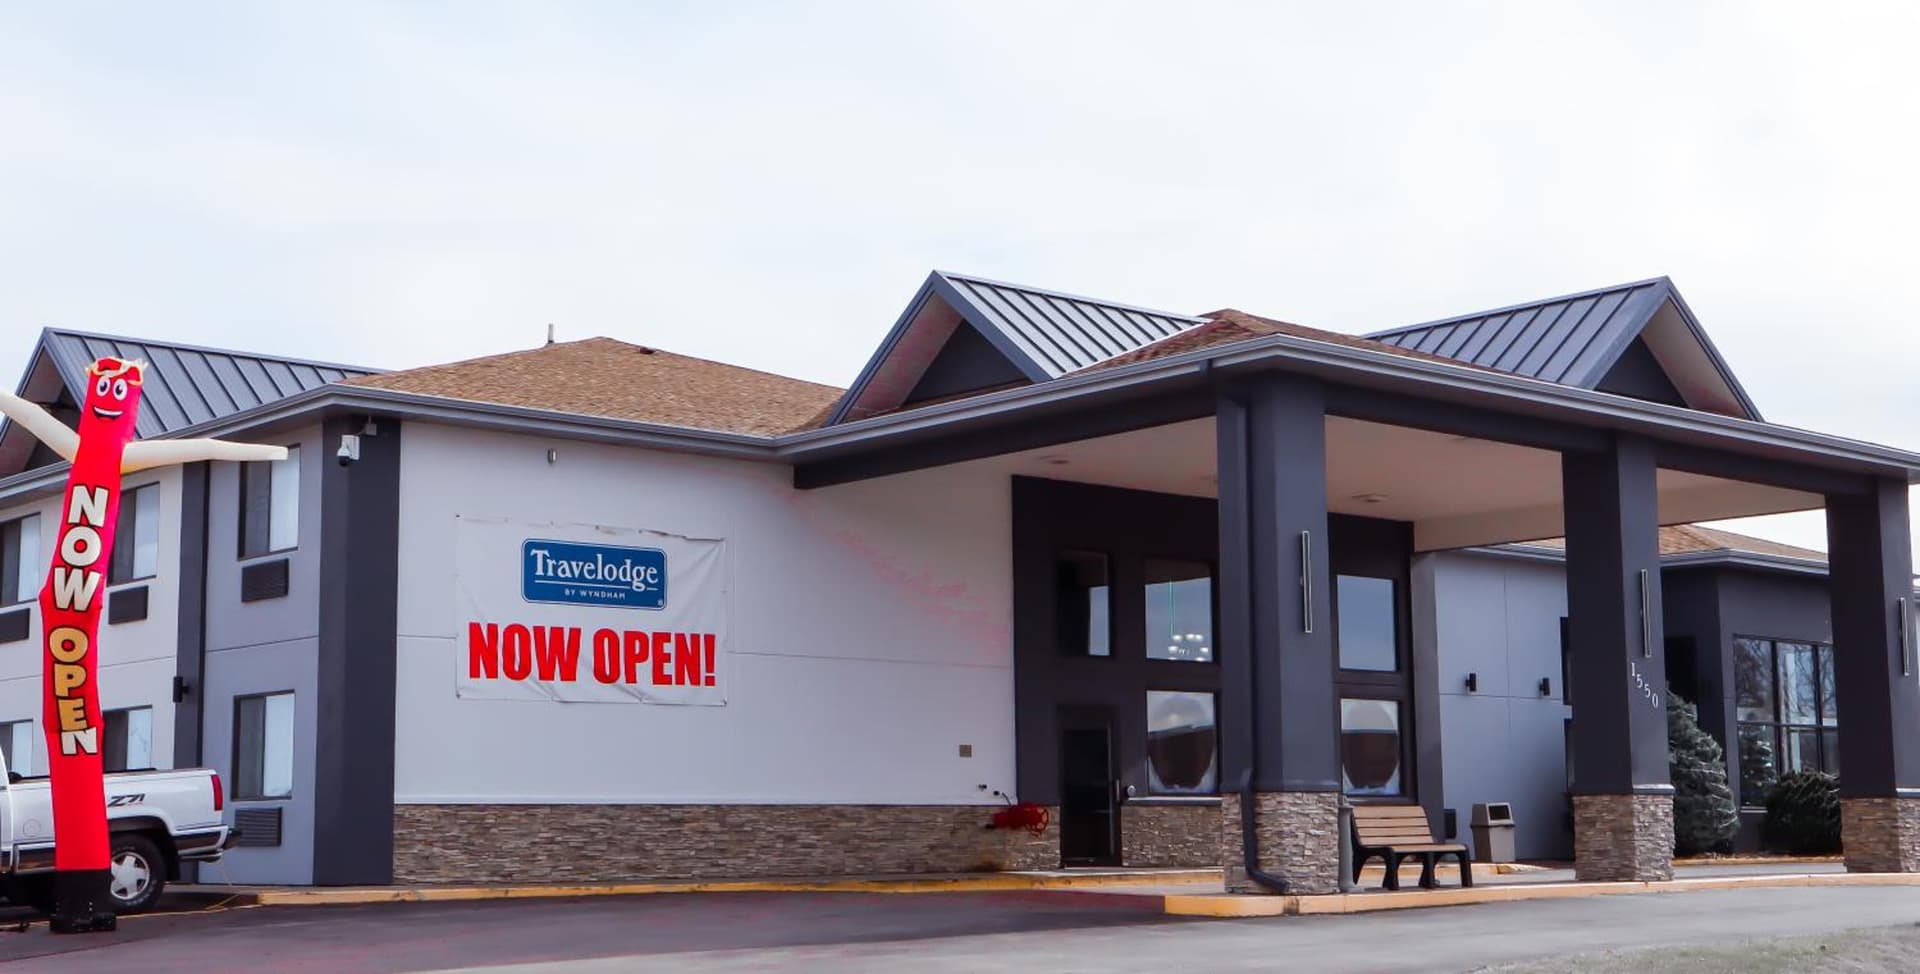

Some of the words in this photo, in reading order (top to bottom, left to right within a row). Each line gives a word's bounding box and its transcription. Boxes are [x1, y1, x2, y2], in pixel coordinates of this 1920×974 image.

[52, 484, 109, 612] NOW
[530, 549, 659, 592] Travelodge
[564, 588, 576, 596] BY
[579, 590, 626, 600] WYNDHAM
[468, 621, 582, 682] NOW
[592, 628, 716, 687] OPEN!
[48, 627, 98, 756] OPEN
[1631, 662, 1659, 708] 1550
[107, 793, 146, 808] Z71
